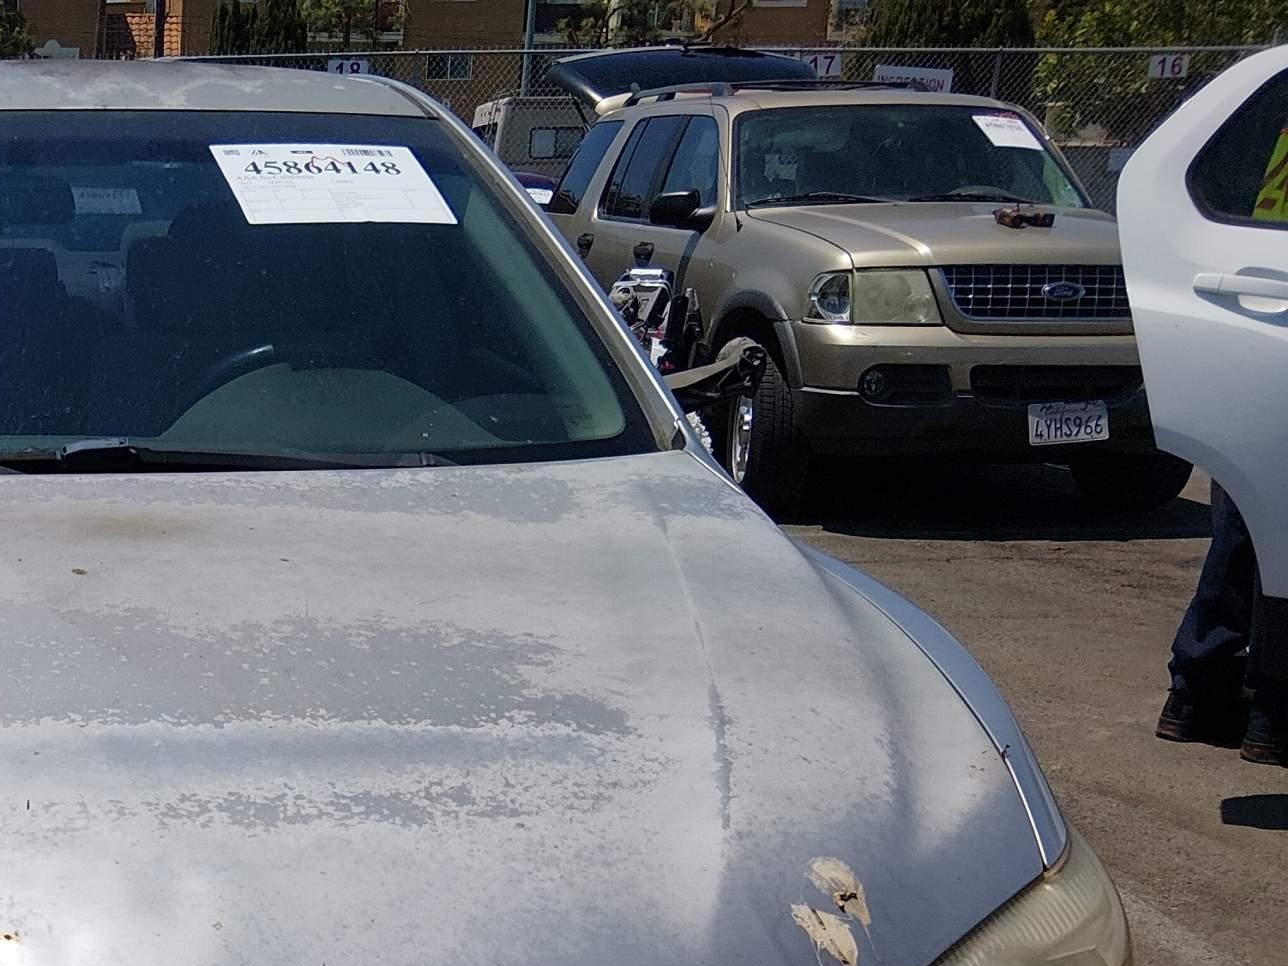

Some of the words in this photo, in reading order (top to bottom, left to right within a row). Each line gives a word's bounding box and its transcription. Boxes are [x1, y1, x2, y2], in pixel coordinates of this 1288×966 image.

[335, 61, 361, 74] 18
[809, 55, 835, 74] 17
[1158, 57, 1183, 76] 16
[245, 160, 402, 175] 45864148
[1034, 415, 1104, 440] 4YHS966
